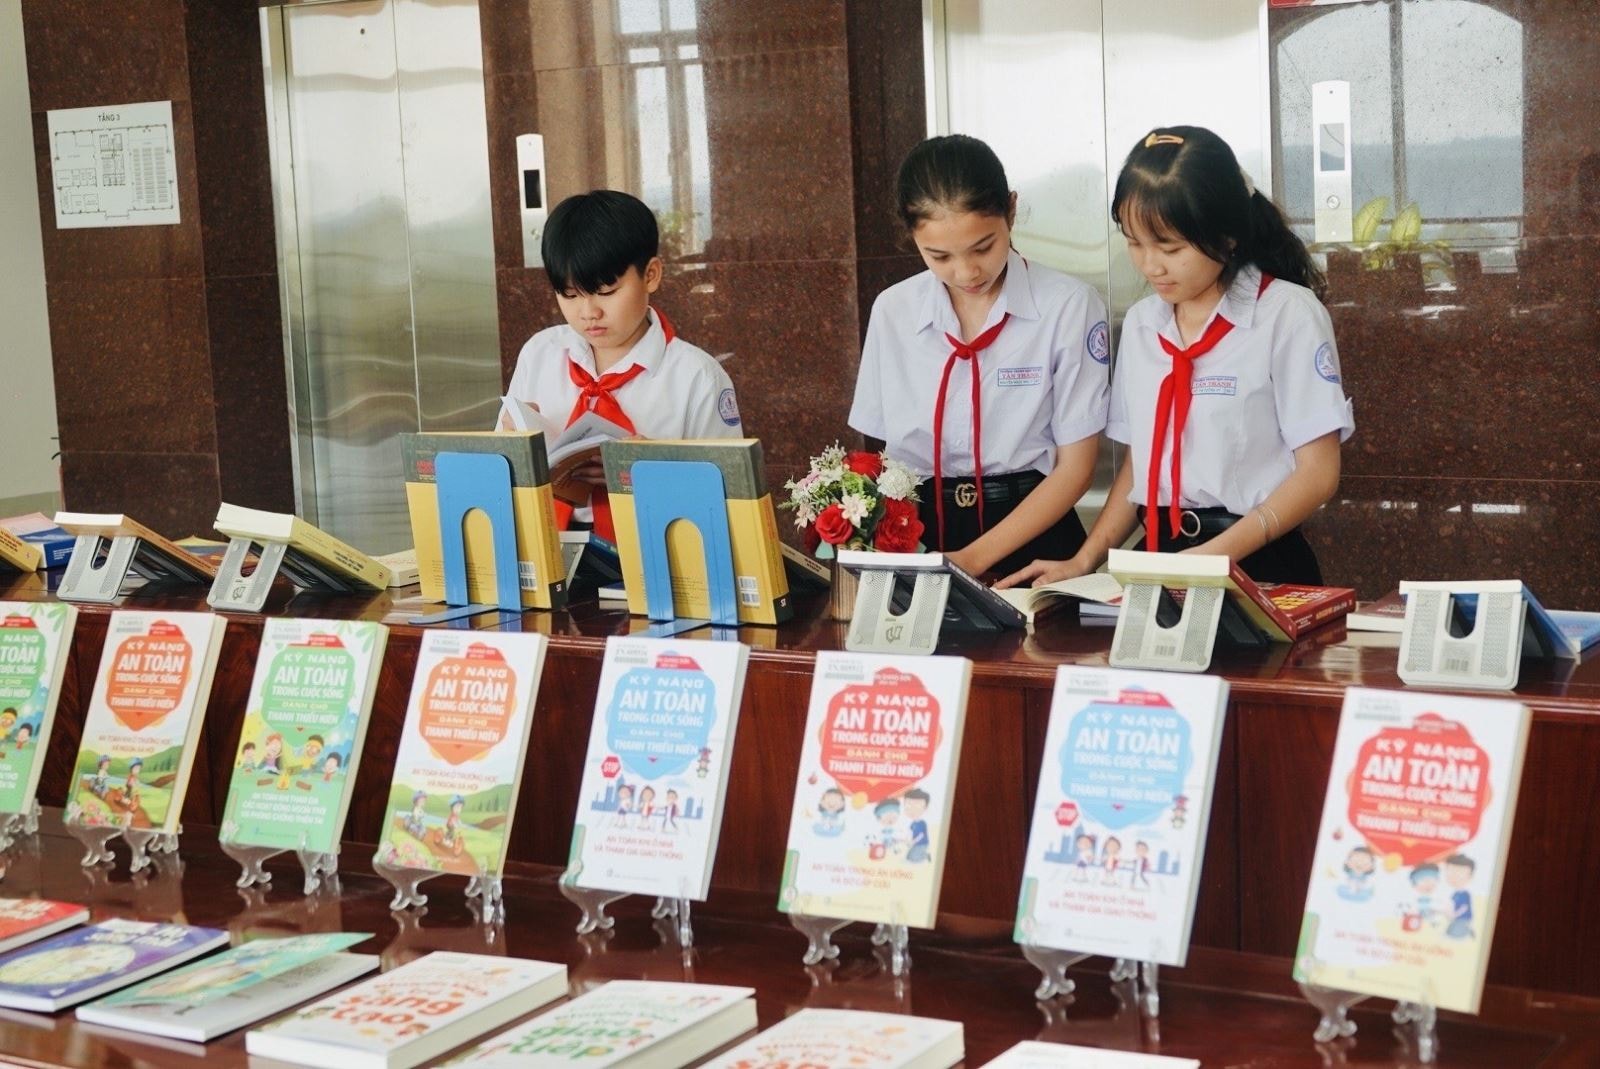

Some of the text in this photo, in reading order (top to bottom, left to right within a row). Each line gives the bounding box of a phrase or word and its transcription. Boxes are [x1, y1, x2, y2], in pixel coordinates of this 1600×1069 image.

[0, 643, 40, 664] TOÀN
[117, 651, 186, 672] AN TOÀN
[115, 673, 139, 682] TRONG
[274, 664, 349, 686] AN TOÀN
[272, 686, 300, 697] TRONG
[432, 677, 509, 702] AN TOÀN
[429, 699, 457, 711] TRONG
[458, 701, 480, 715] CUỘC
[621, 688, 706, 713] AN TOÀN
[468, 718, 488, 727] CHO
[618, 711, 648, 723] TRONG
[833, 706, 931, 734] AN TOÀN
[425, 726, 452, 738] THANH
[832, 730, 869, 744] TRONG
[870, 731, 898, 747] CUỘC
[615, 739, 645, 751] THANH
[1075, 727, 1180, 758] AN TOÀN
[884, 751, 909, 761] CHO
[829, 760, 865, 773] THANH
[1362, 754, 1480, 792] AN TOÀN
